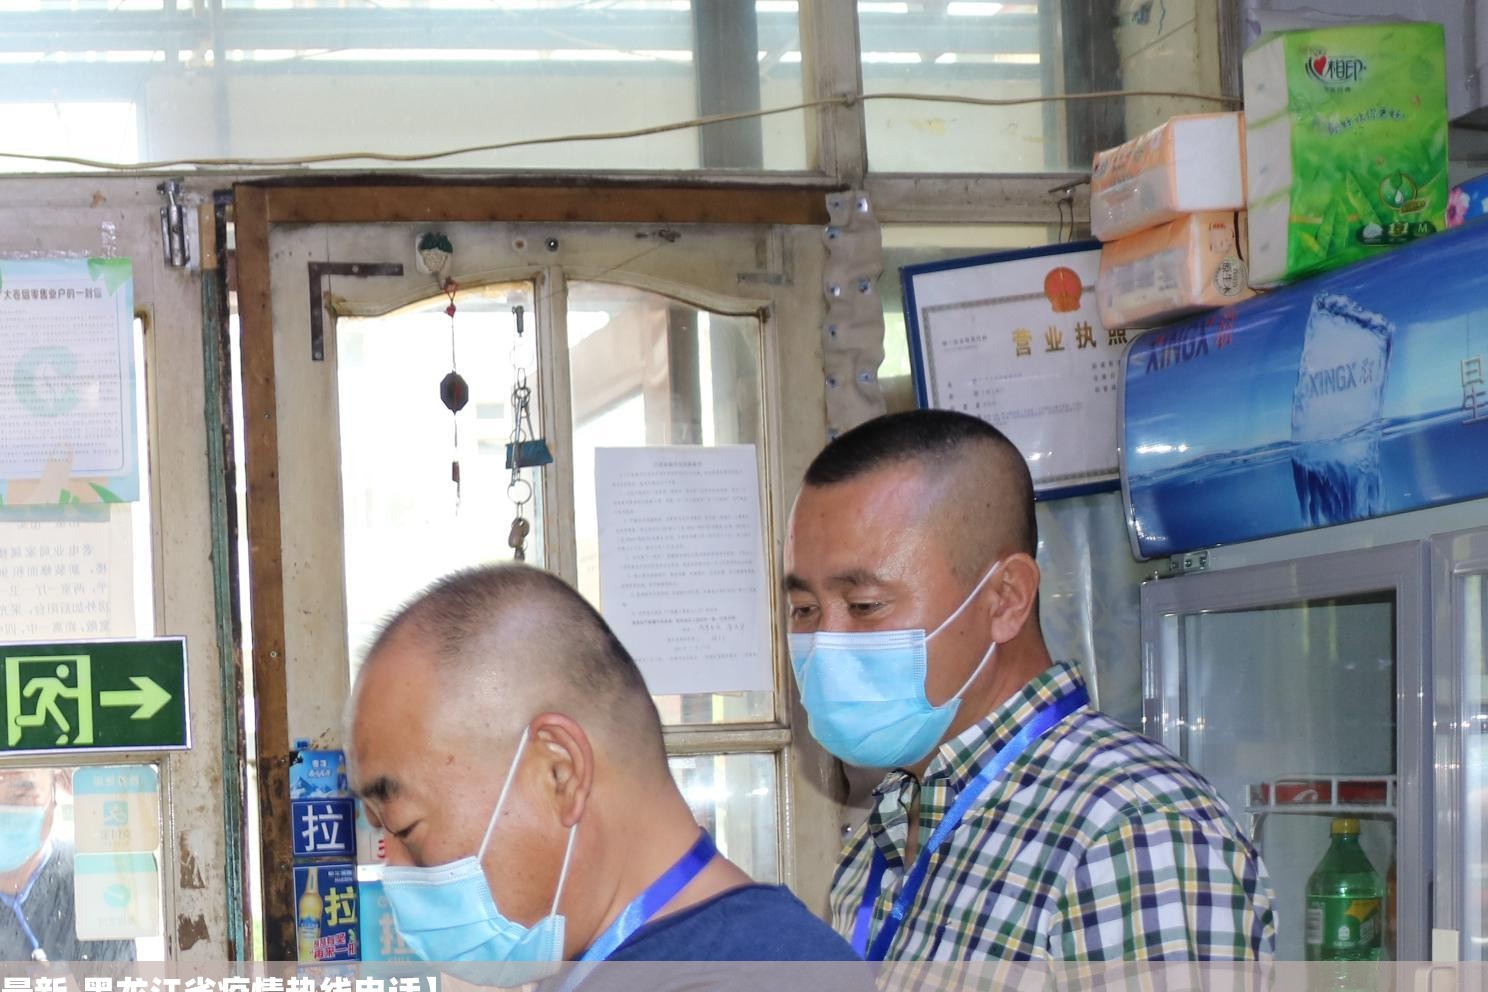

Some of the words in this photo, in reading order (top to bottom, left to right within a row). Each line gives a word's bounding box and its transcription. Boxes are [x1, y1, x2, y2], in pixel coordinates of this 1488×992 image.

[1013, 321, 1127, 357] 营业执照
[1309, 362, 1357, 397] XINGX
[302, 804, 346, 851] 拉
[325, 886, 357, 926] 拉
